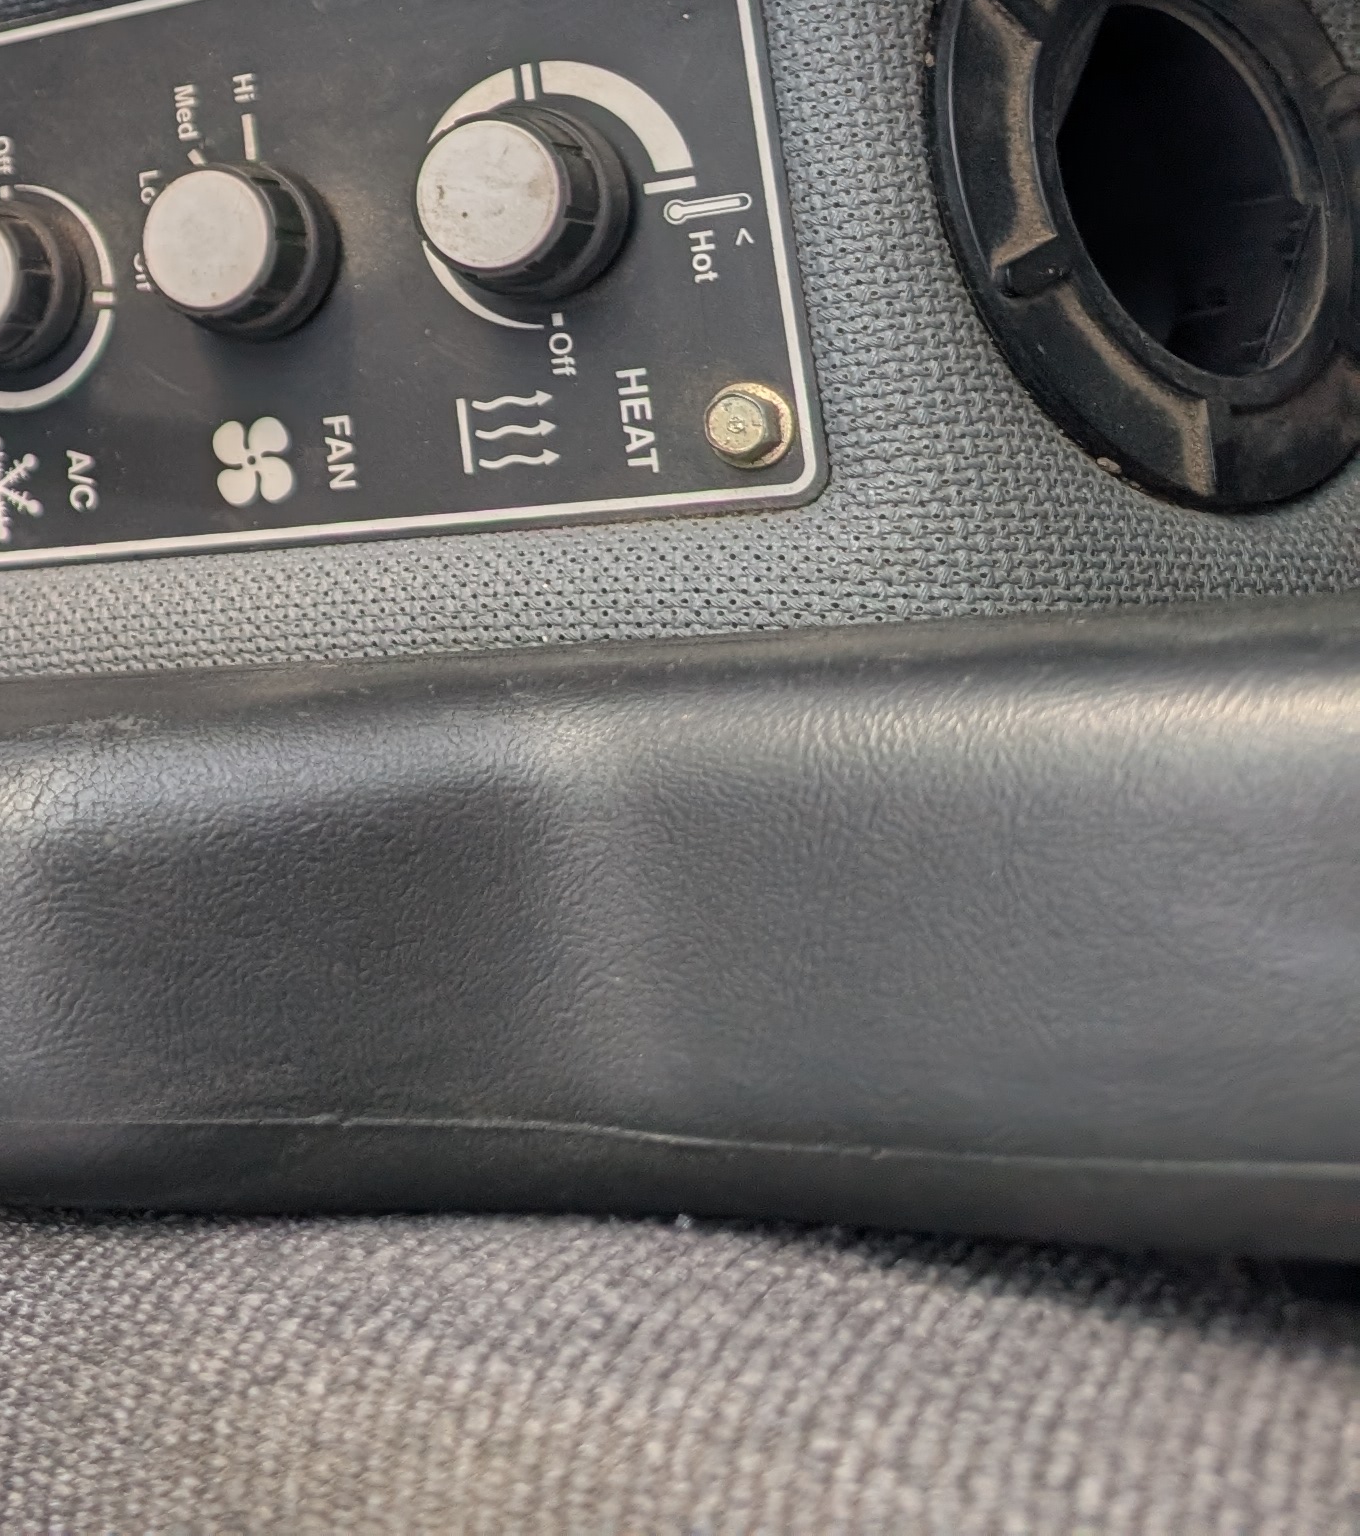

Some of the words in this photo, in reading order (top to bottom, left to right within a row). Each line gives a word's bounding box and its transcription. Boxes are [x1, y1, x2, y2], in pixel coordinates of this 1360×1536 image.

[173, 83, 200, 141] Med
[232, 72, 257, 104] Hi
[688, 229, 719, 284] Hot
[548, 332, 577, 376] Off
[615, 367, 660, 474] HEAT
[66, 448, 99, 512] A/C
[322, 414, 358, 491] FAN
